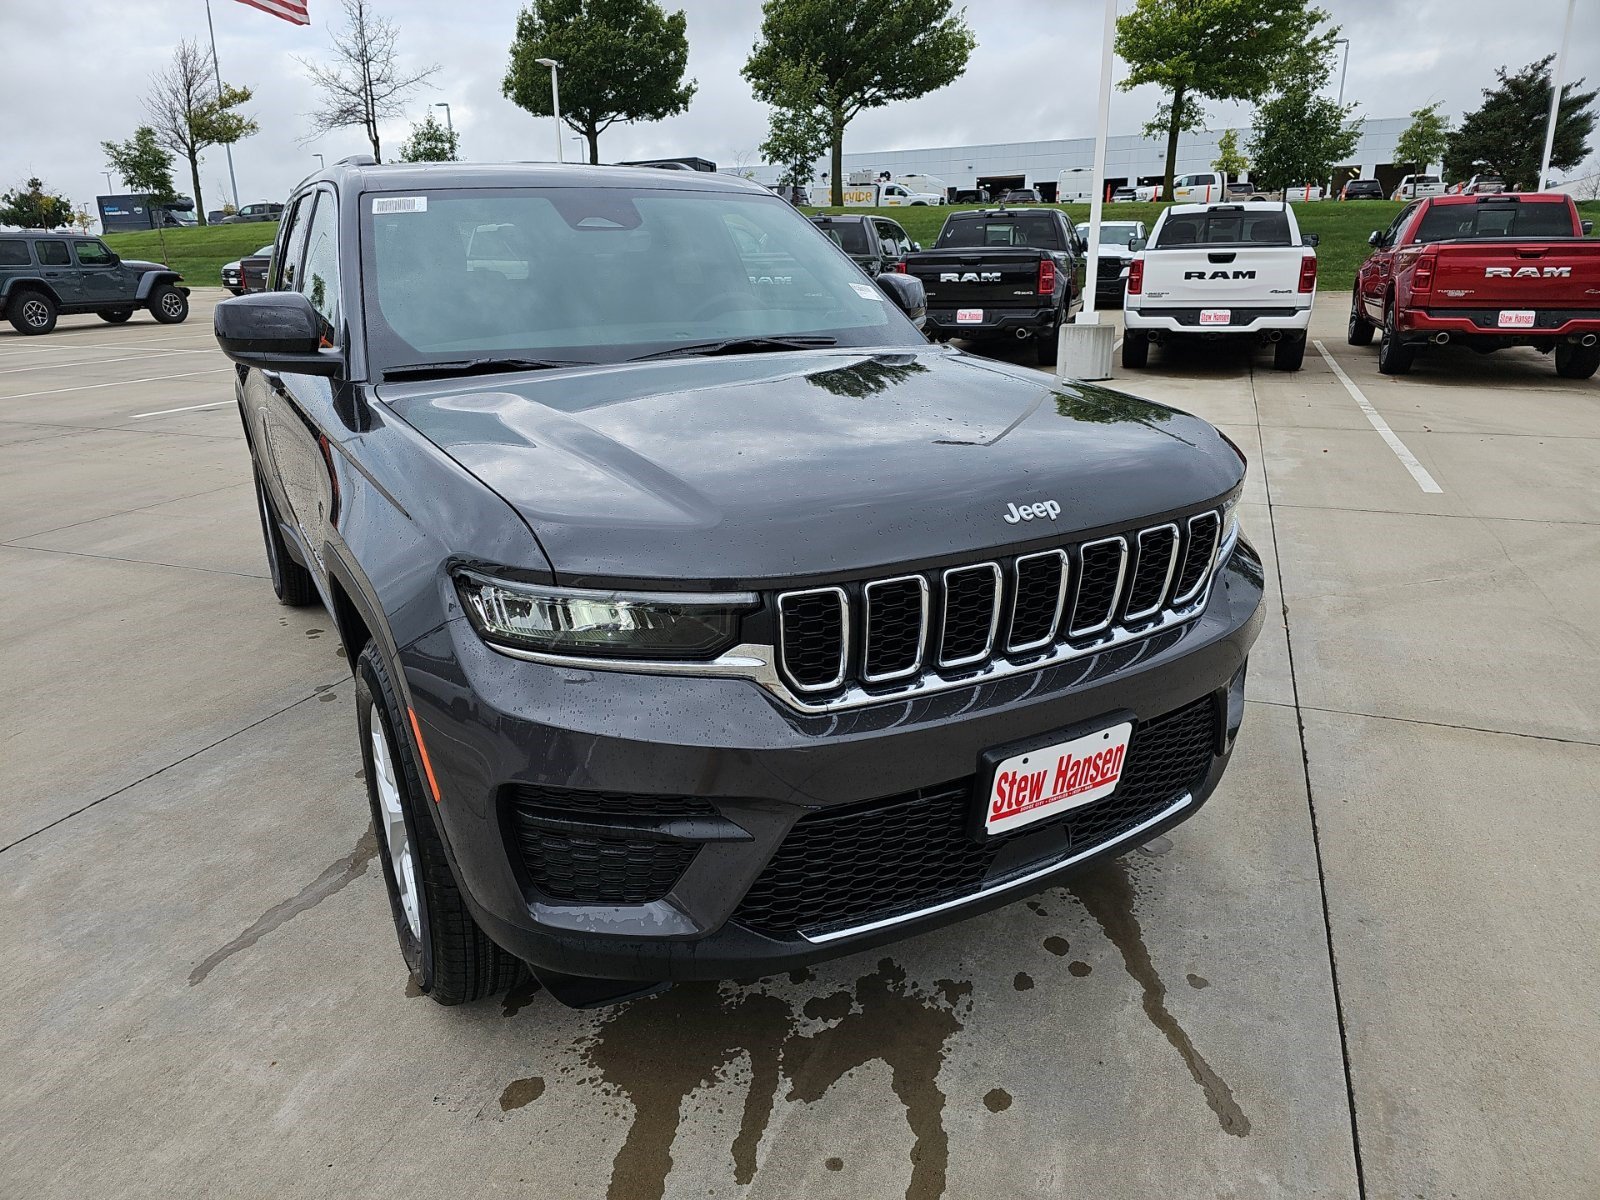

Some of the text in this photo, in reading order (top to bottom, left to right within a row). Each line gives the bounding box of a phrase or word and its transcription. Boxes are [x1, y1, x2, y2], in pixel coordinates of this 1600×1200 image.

[828, 189, 872, 203] rvice
[940, 273, 1001, 282] RAM
[1184, 271, 1256, 280] RAM
[1485, 267, 1572, 278] RAM
[1500, 313, 1534, 324] Stew Hansen
[1003, 500, 1061, 524] Jeep
[993, 744, 1125, 813] Stew Hansen
